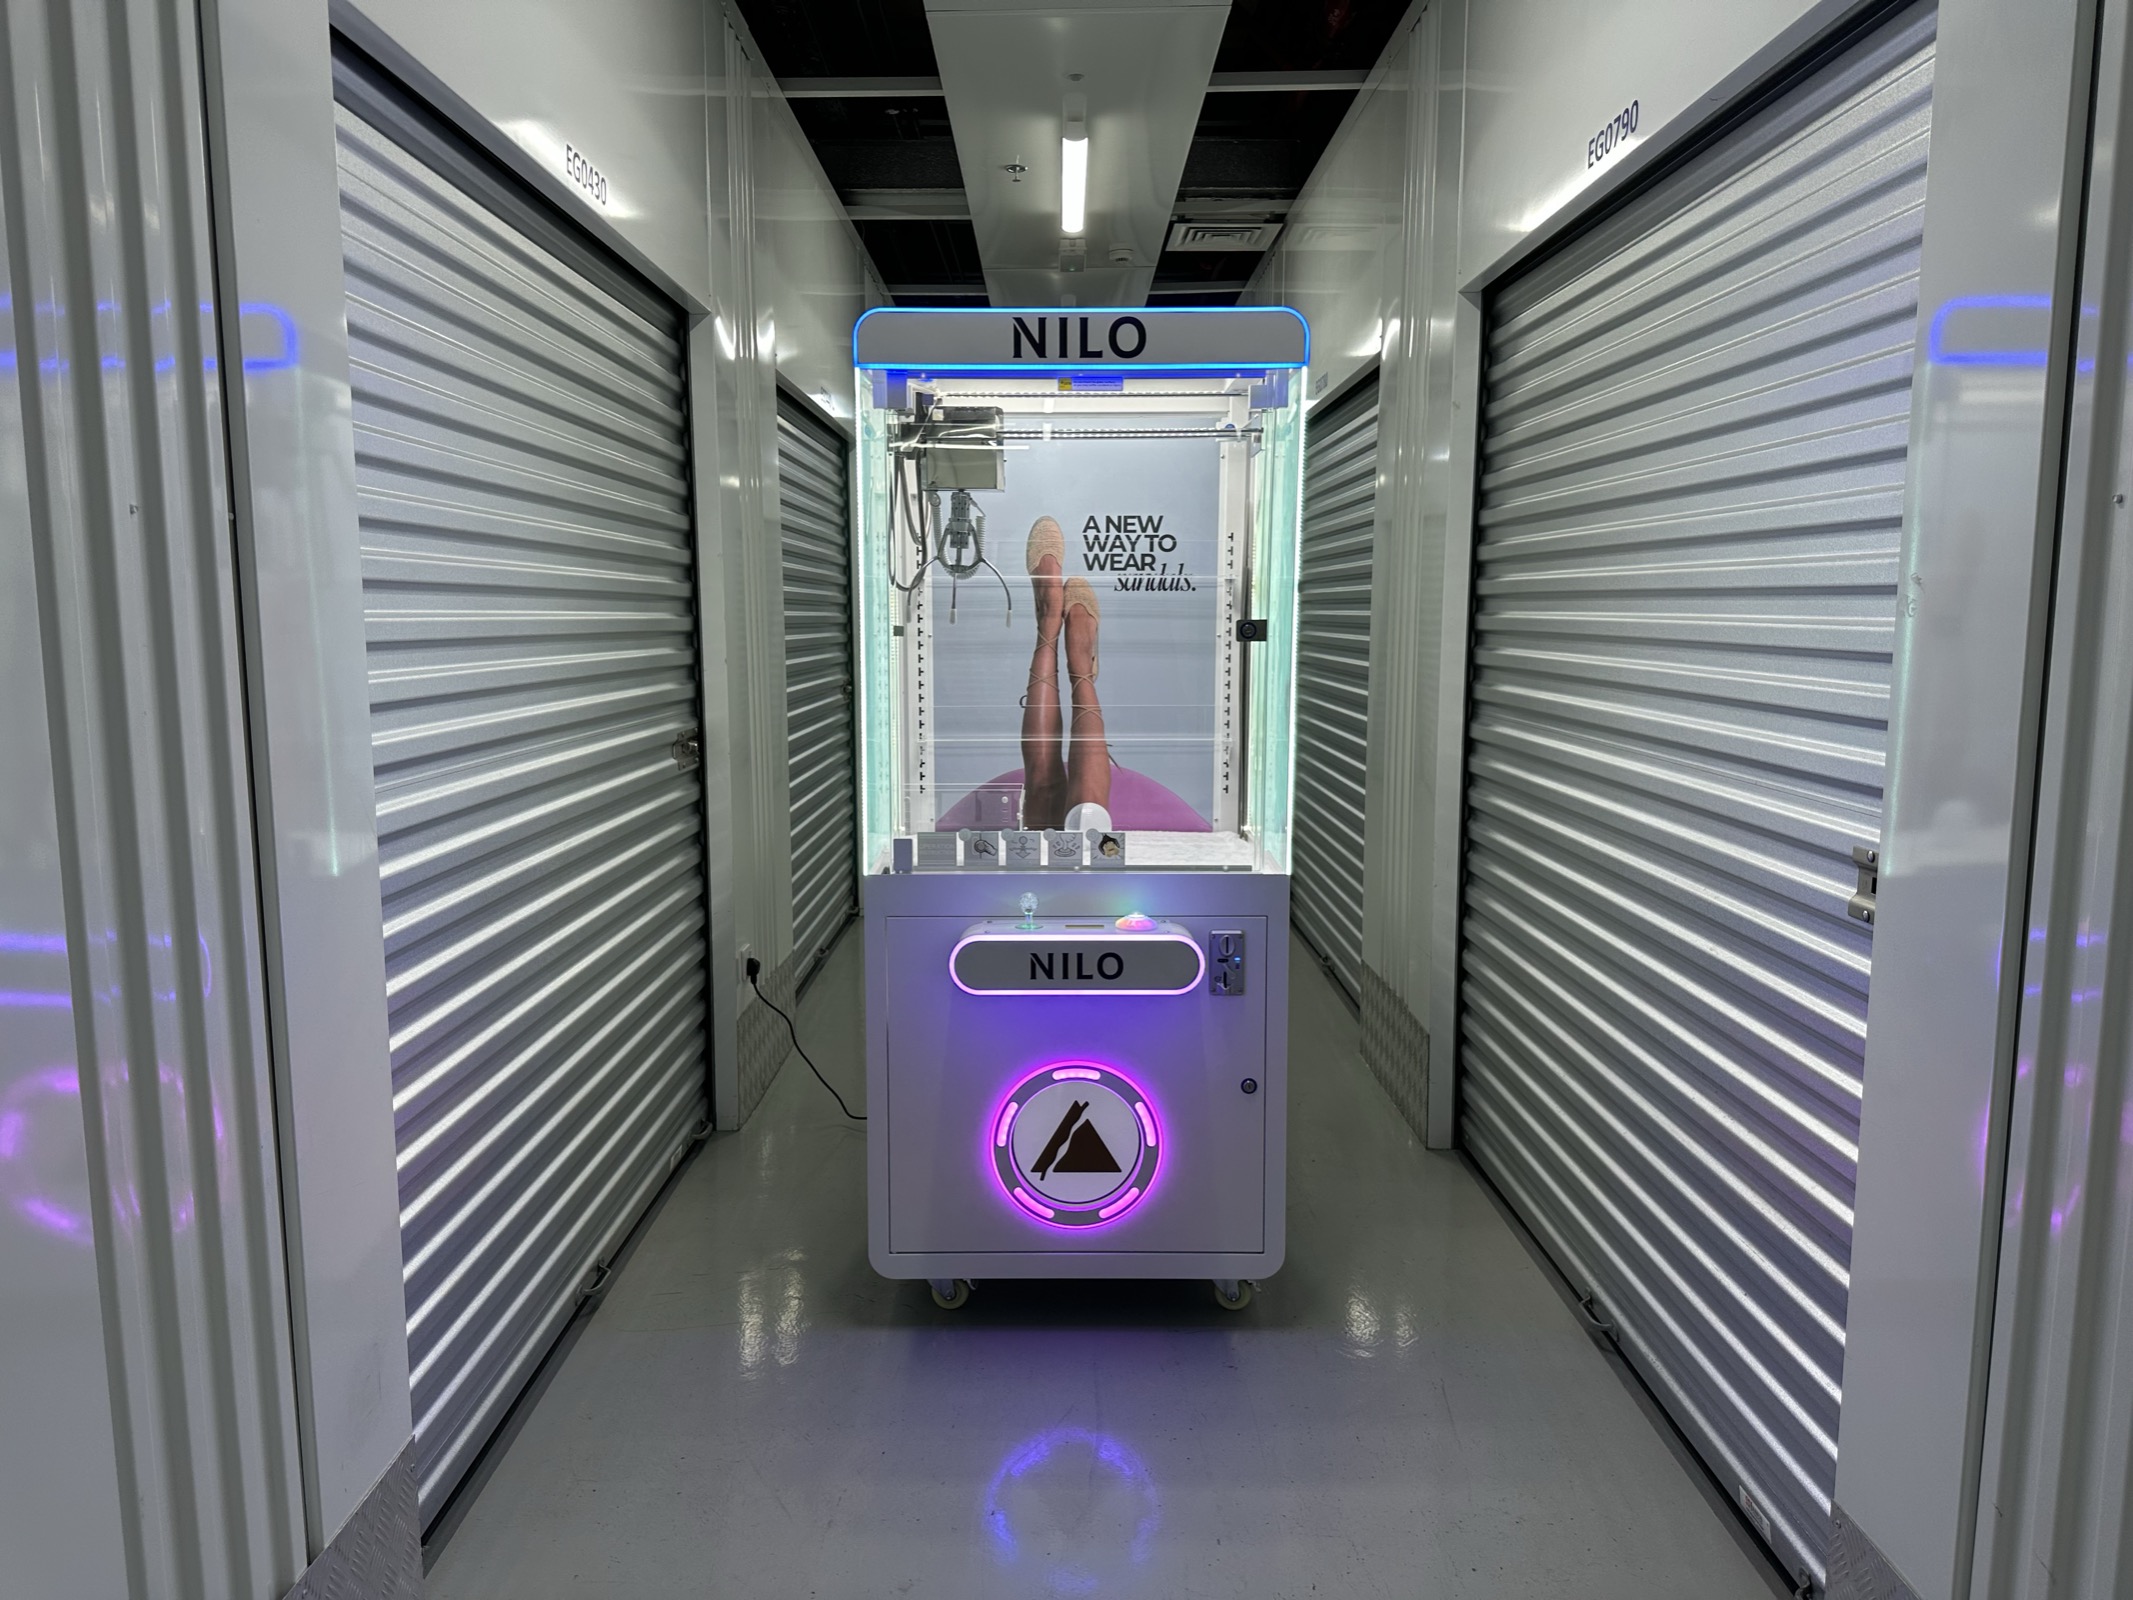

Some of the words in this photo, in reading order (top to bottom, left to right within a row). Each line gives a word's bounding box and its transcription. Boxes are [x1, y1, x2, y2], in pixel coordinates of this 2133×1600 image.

[1588, 100, 1639, 169] EG0790
[566, 144, 607, 206] EG0430
[1012, 316, 1147, 359] NILO
[1082, 515, 1101, 533] A
[1105, 515, 1164, 533] NEW
[1083, 534, 1142, 552] WAY
[1144, 534, 1177, 552] TO
[1083, 553, 1156, 571] WEAR
[1030, 952, 1124, 980] NILO
